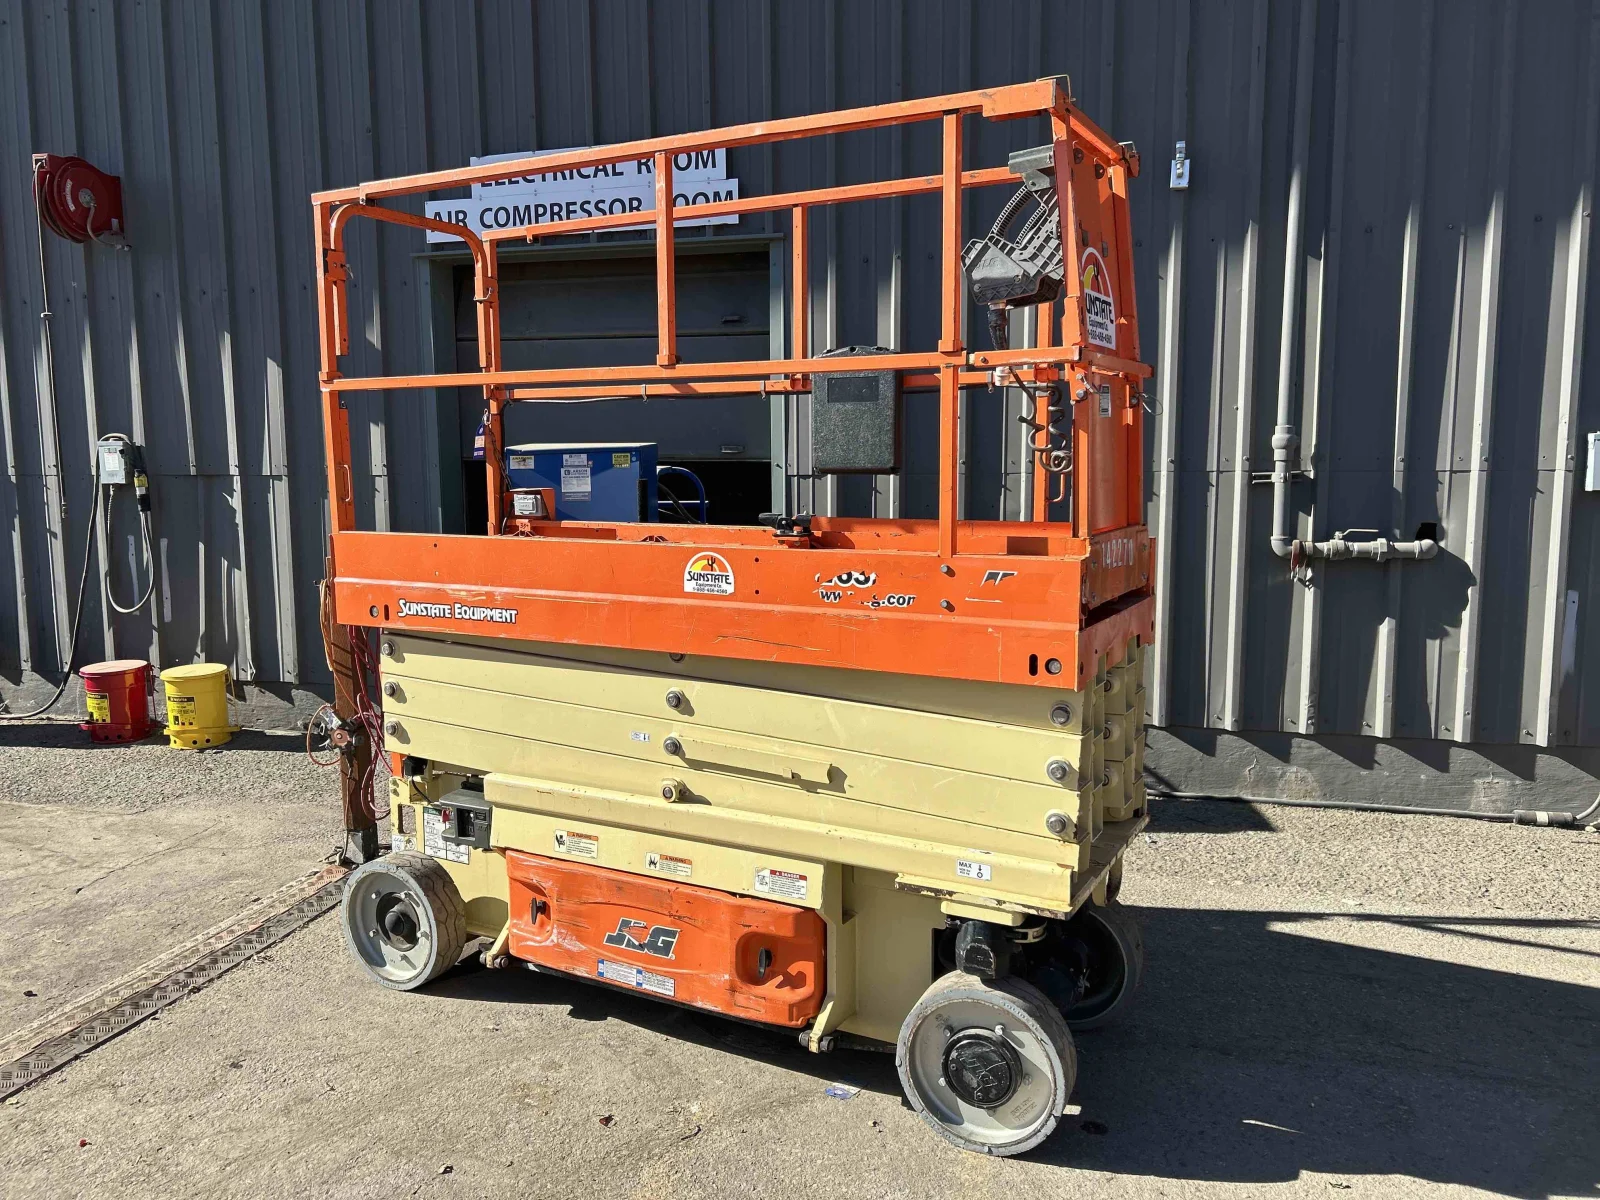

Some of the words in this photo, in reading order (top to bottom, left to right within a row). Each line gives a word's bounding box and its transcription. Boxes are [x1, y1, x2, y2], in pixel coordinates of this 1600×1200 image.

[480, 161, 624, 188] RICAL
[637, 149, 717, 174] ROM
[428, 209, 469, 233] AIR
[479, 196, 643, 229] COMPRESSOR
[673, 189, 734, 208] OOM
[1085, 292, 1114, 324] UNSTATE
